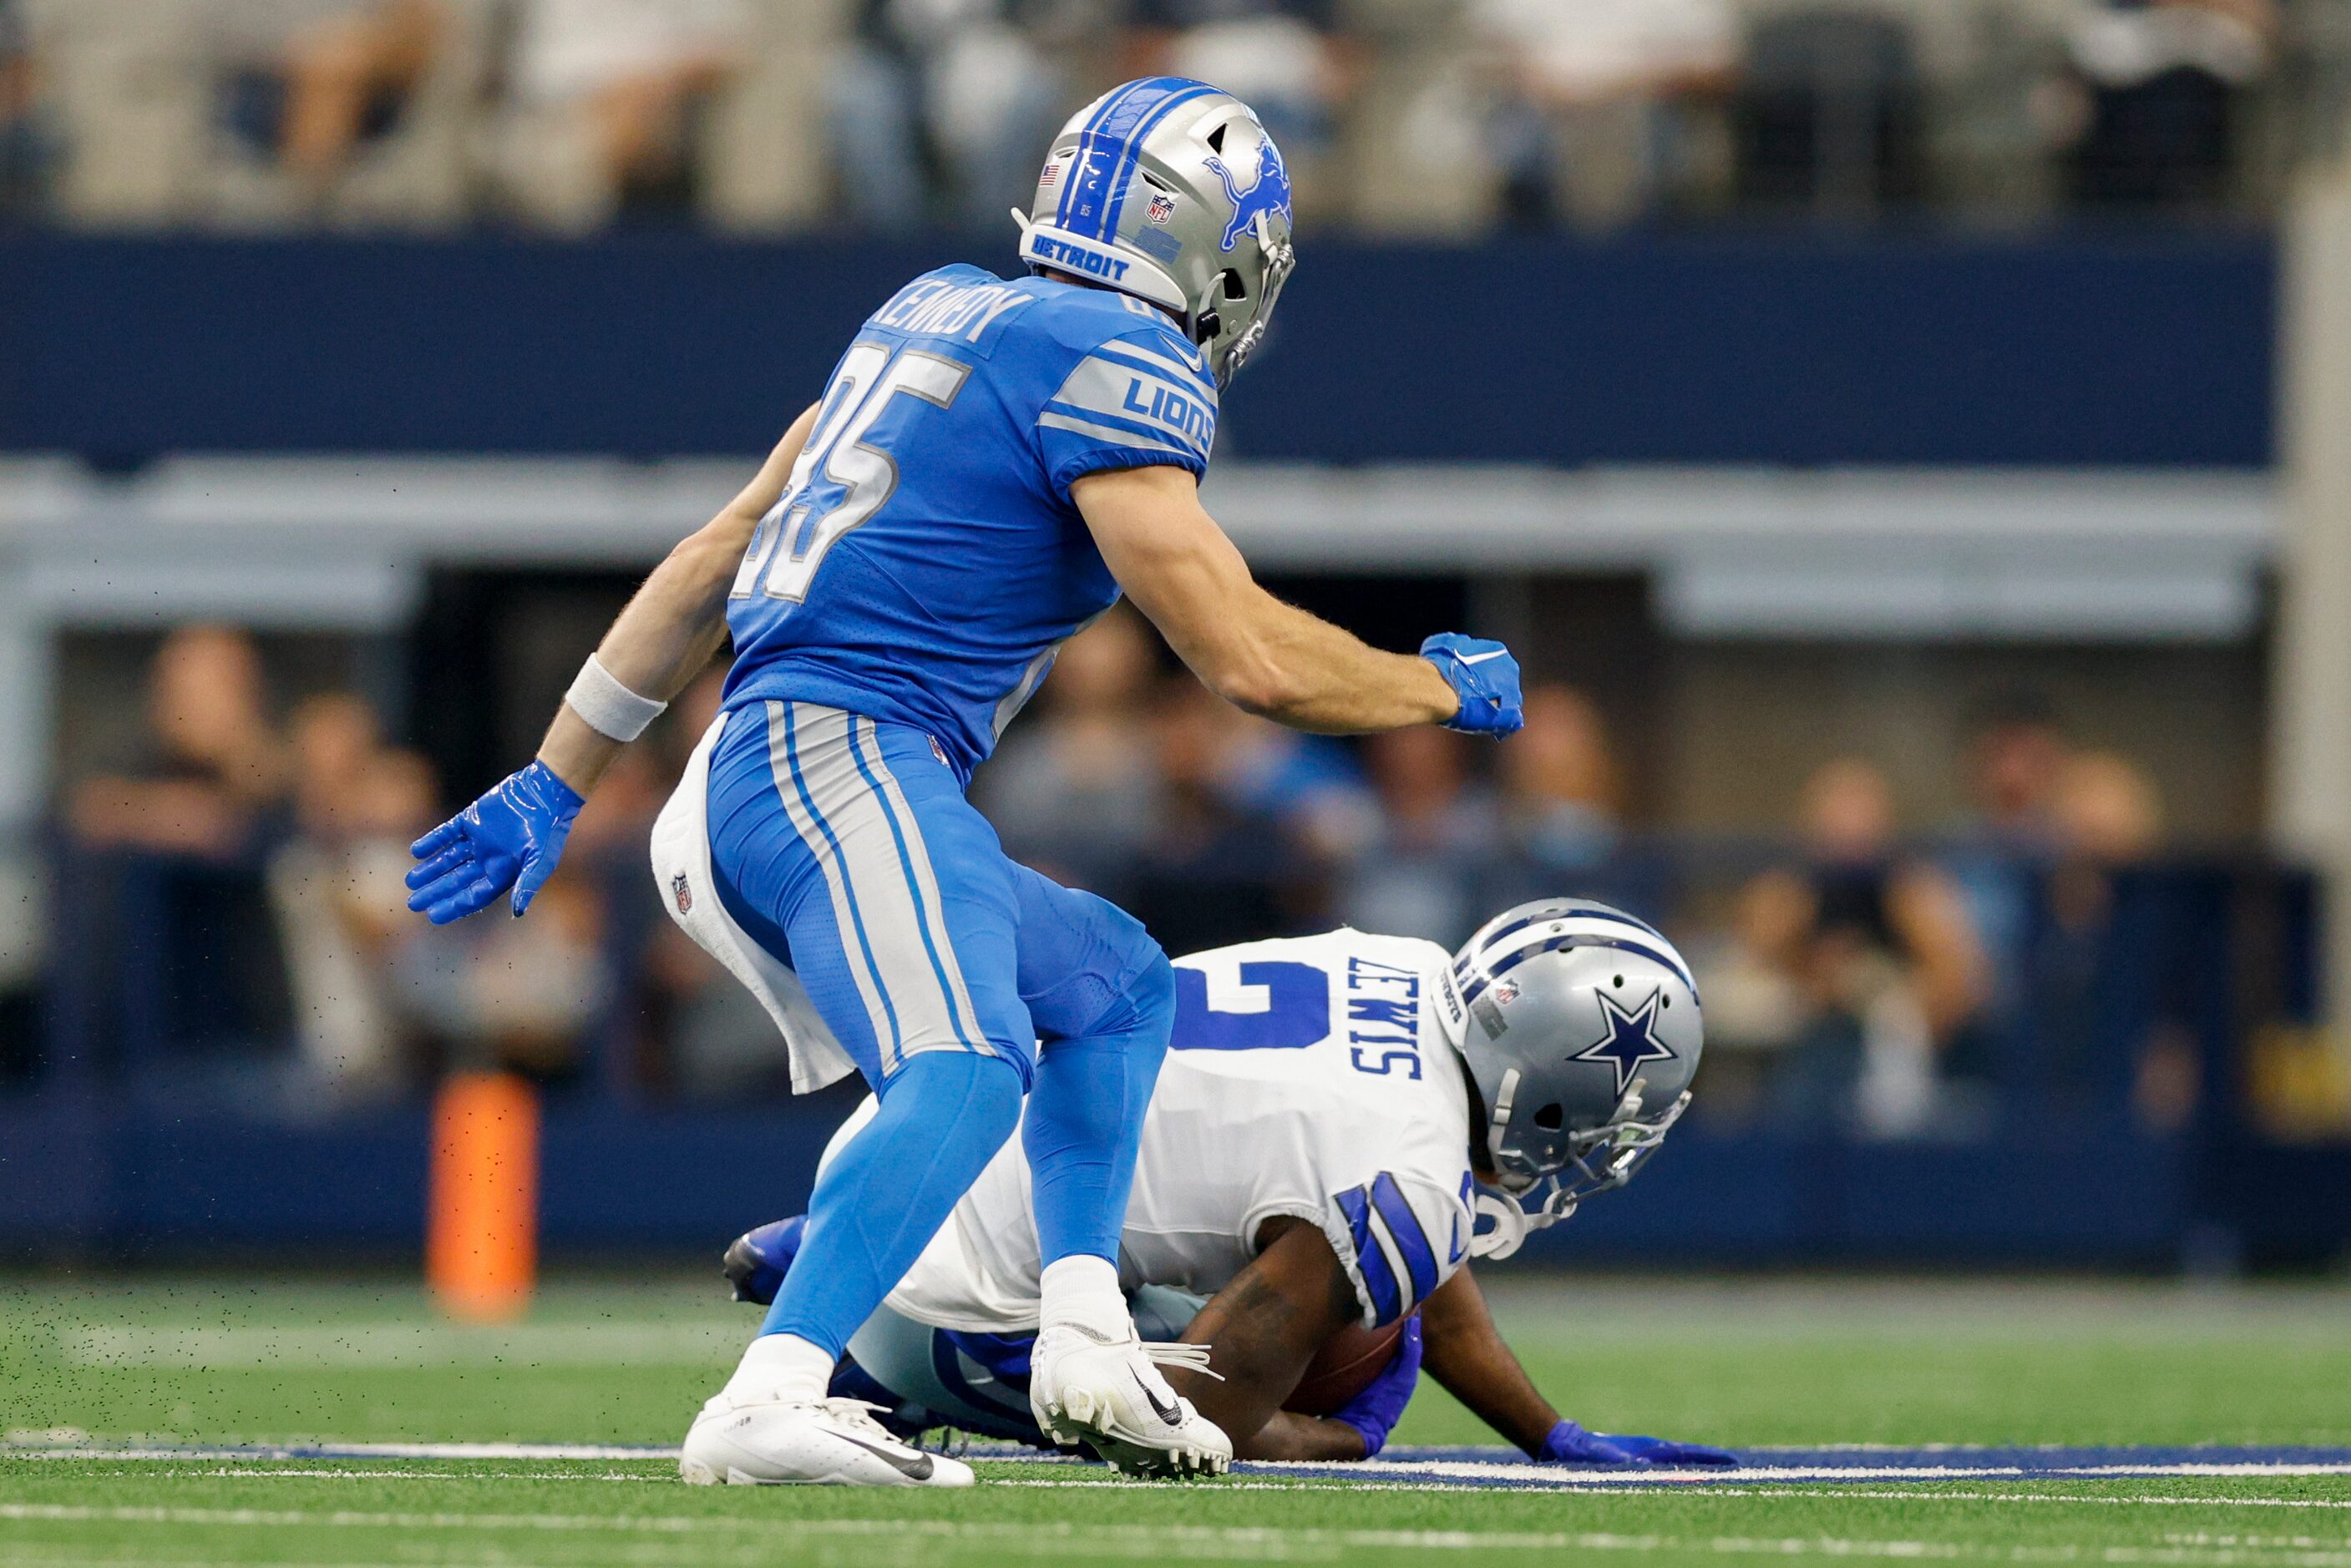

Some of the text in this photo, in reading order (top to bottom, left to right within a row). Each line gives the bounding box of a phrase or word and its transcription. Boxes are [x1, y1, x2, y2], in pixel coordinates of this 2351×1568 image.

[1148, 203, 1168, 221] NFL
[1031, 234, 1130, 281] DETROIT
[1122, 377, 1216, 454] LIONS
[1348, 956, 1422, 1080] LEWIS
